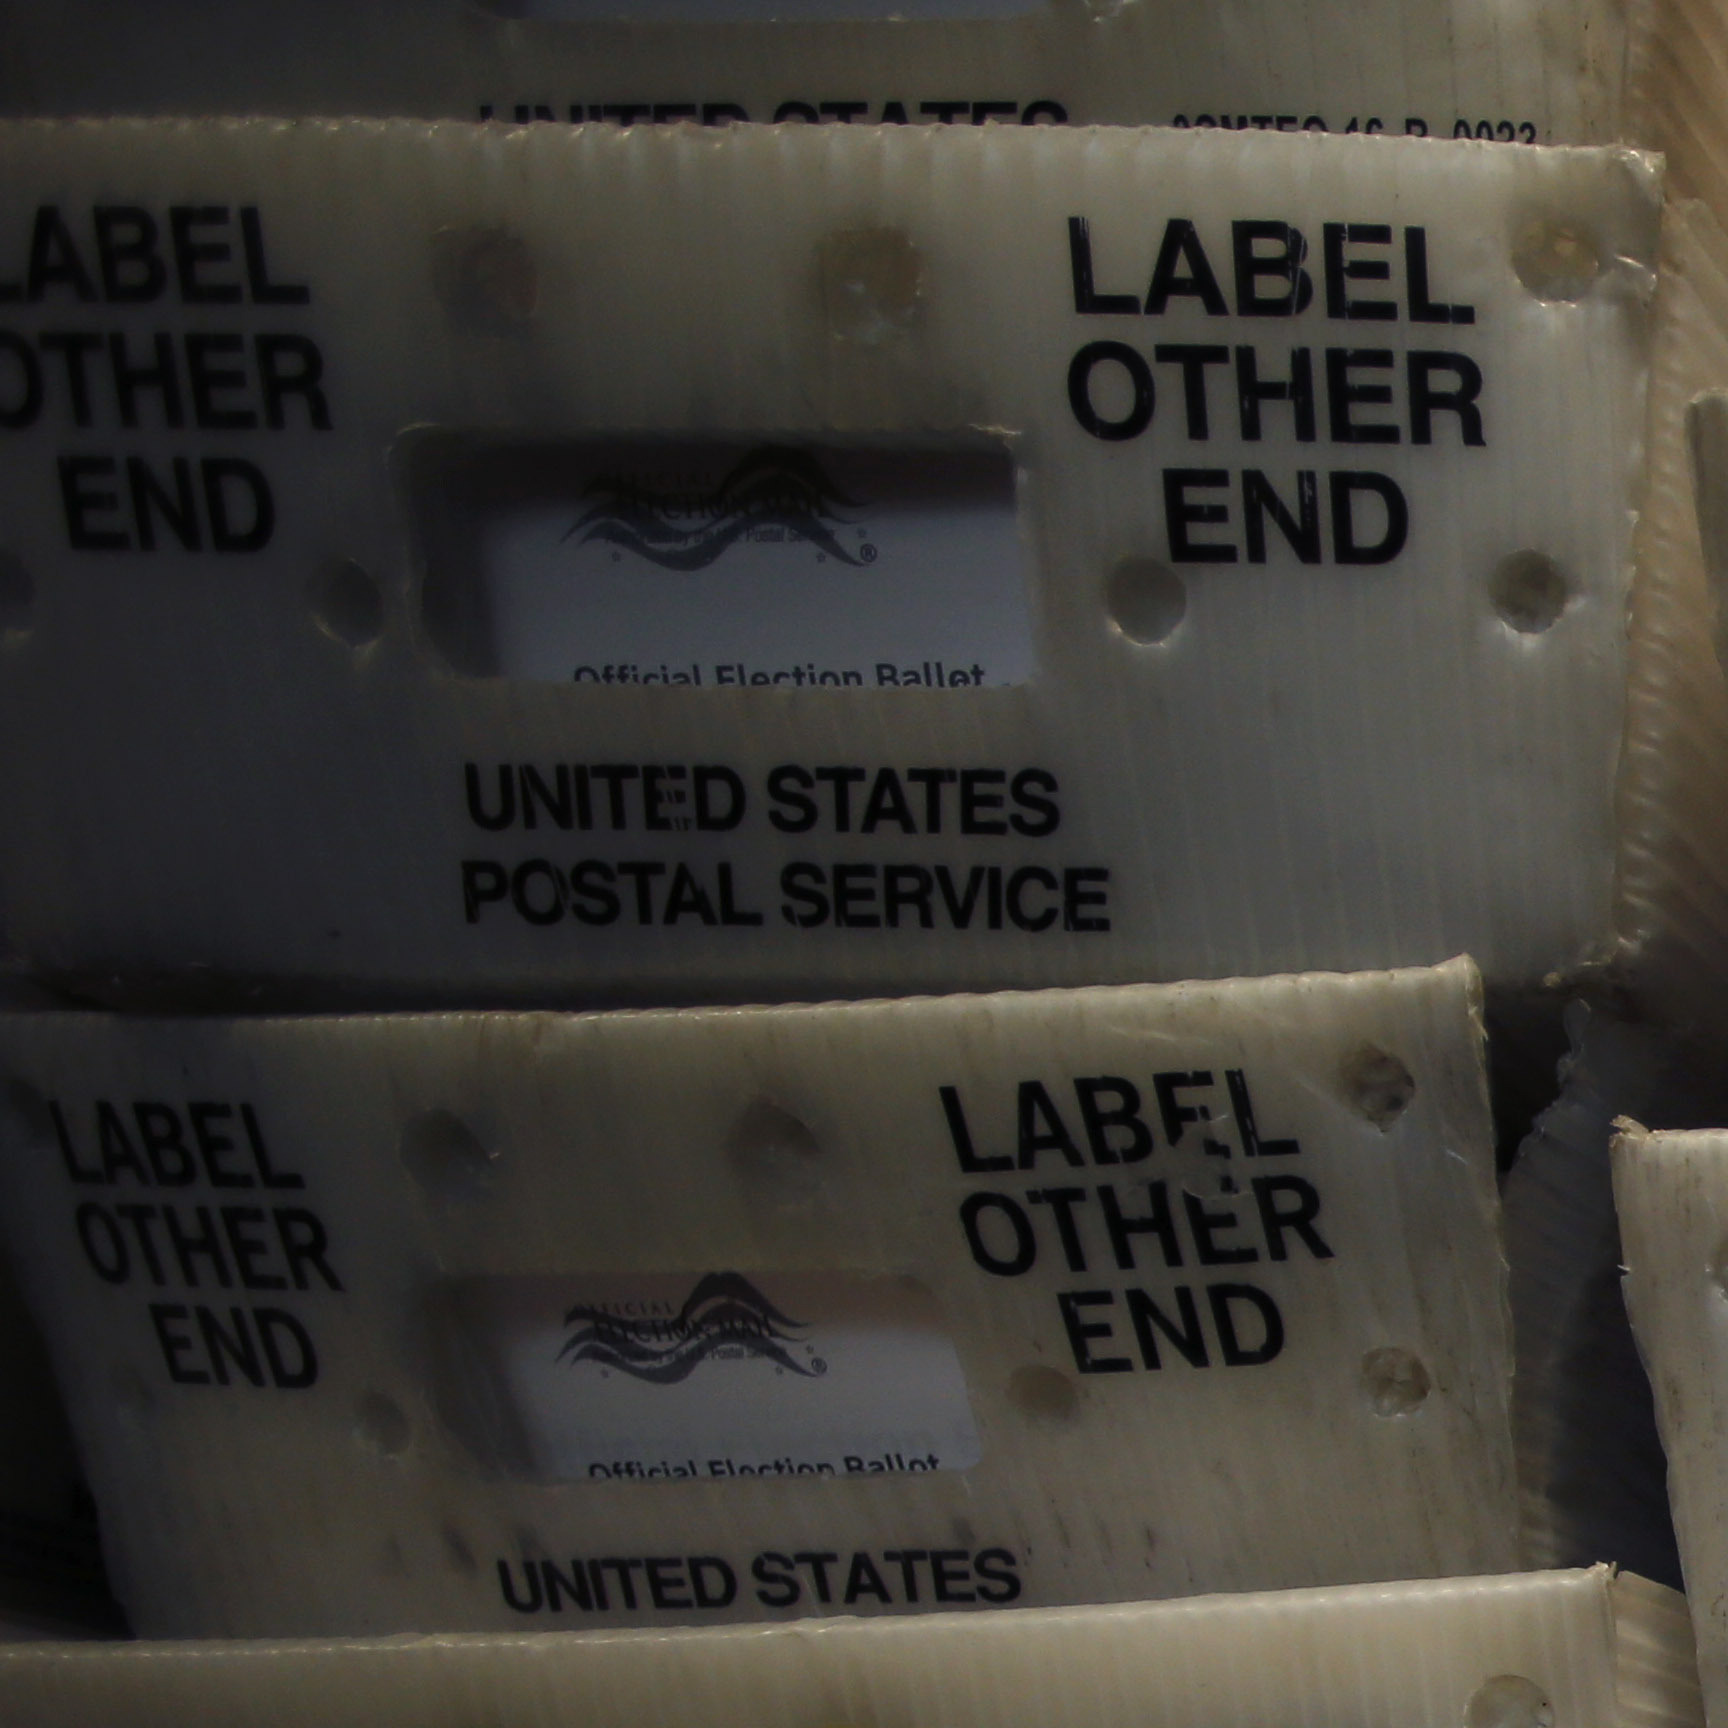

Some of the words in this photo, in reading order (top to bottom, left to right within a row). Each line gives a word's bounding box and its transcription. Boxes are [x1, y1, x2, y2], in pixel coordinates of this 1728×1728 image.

[1066, 216, 1476, 325] LABEL
[1066, 341, 1487, 448] OTHER
[1163, 468, 1411, 566] END
[464, 762, 747, 832] UNITED
[765, 768, 1062, 836] STATES
[460, 858, 764, 926] POSTAL
[781, 861, 1111, 933] SERVICE
[49, 1098, 304, 1189] LABEL
[72, 1201, 346, 1291] OTHER
[958, 1180, 1333, 1278] OTHER
[150, 1301, 320, 1390] END
[1060, 1287, 1287, 1373] END
[502, 1555, 738, 1613] UNITED
[757, 1547, 1023, 1607] STATES
